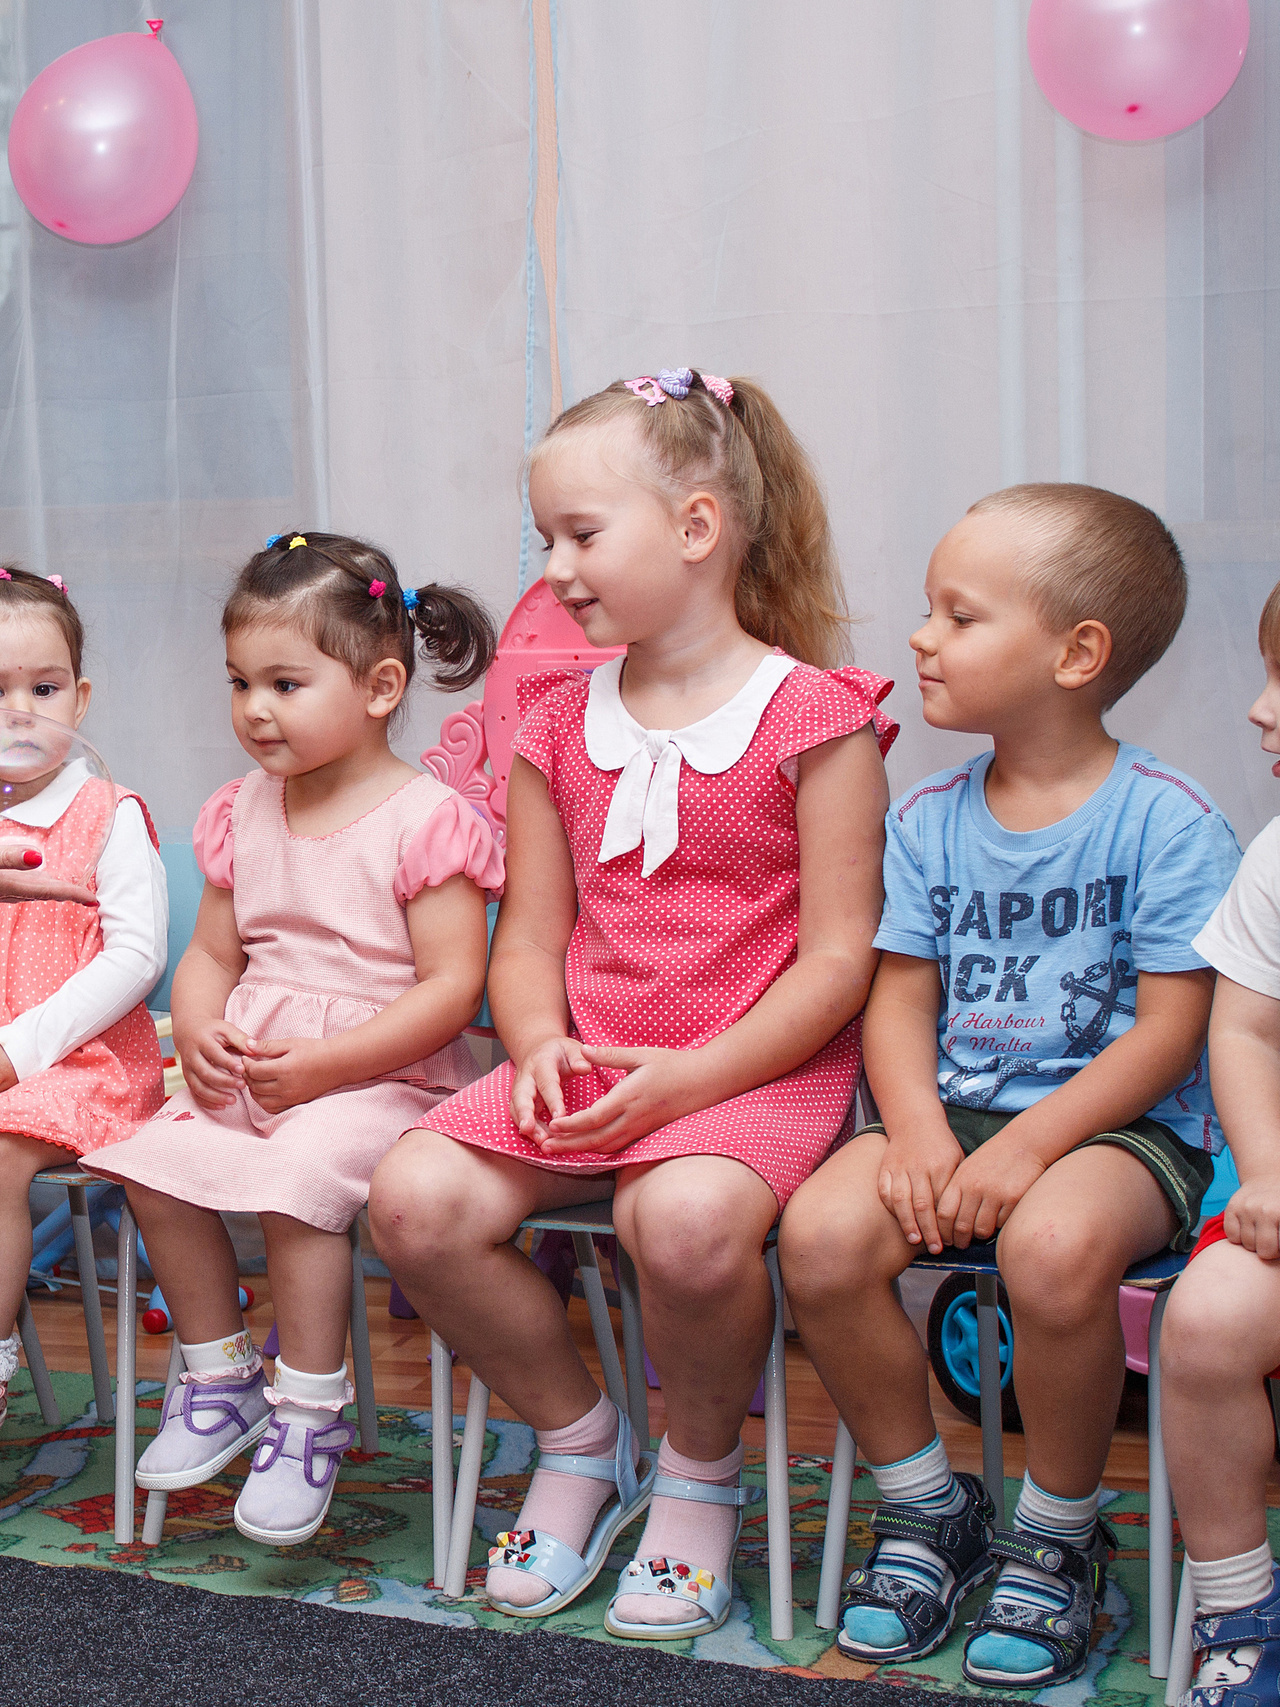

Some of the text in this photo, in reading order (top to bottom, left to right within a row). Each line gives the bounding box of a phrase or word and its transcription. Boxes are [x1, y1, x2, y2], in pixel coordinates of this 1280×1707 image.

[929, 875, 1128, 940] SAPORT
[962, 1013, 1045, 1029] Harbour
[970, 1037, 1032, 1052] Malta
